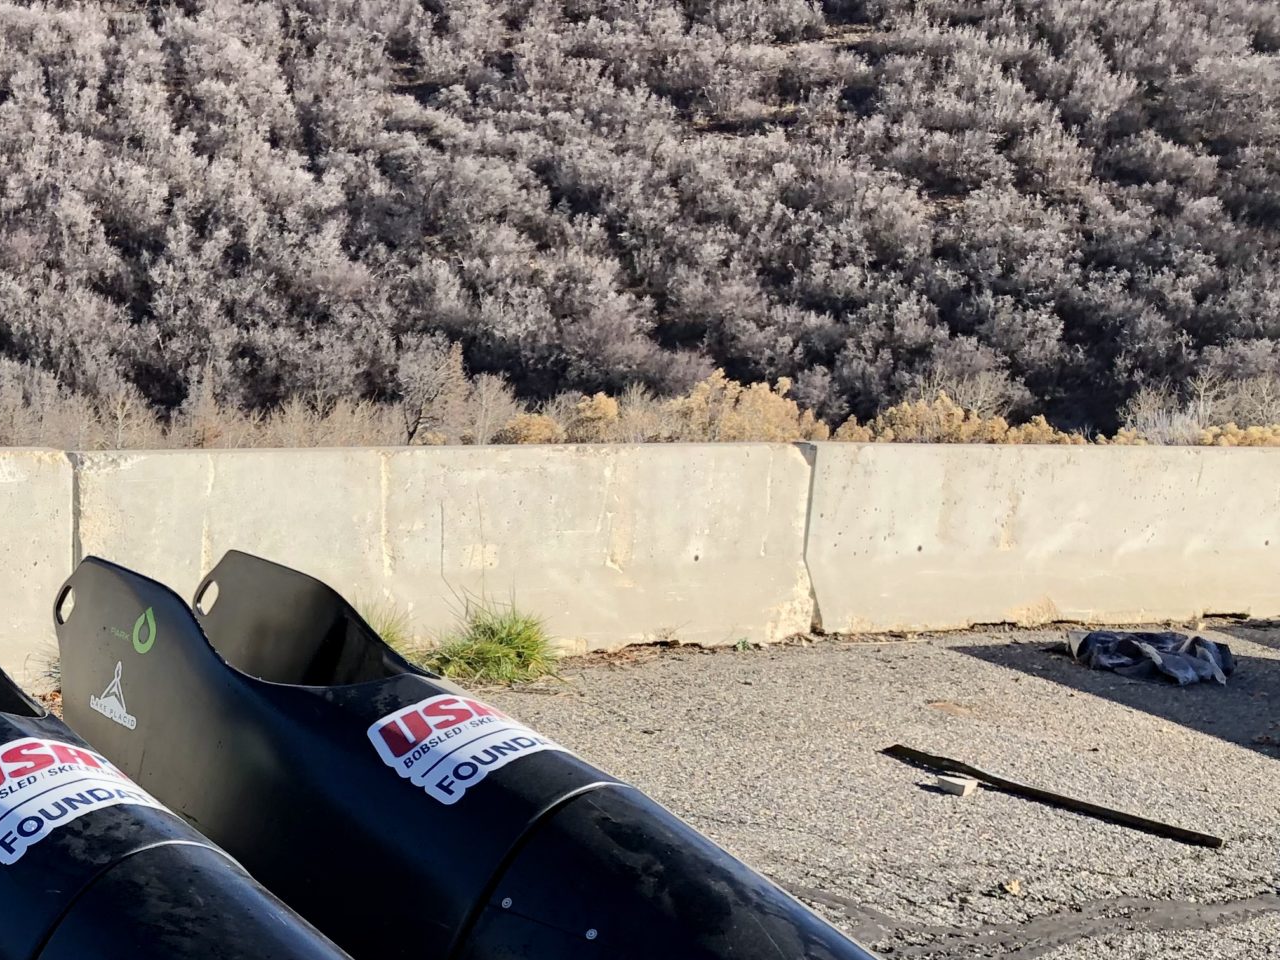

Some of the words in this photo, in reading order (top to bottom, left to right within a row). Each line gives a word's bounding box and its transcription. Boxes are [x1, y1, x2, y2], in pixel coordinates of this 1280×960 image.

[90, 699, 107, 713] LAKE
[109, 708, 135, 727] PLACID
[378, 697, 507, 758] USA
[403, 727, 462, 769] BOBSLED
[435, 736, 551, 796] FOUNDA
